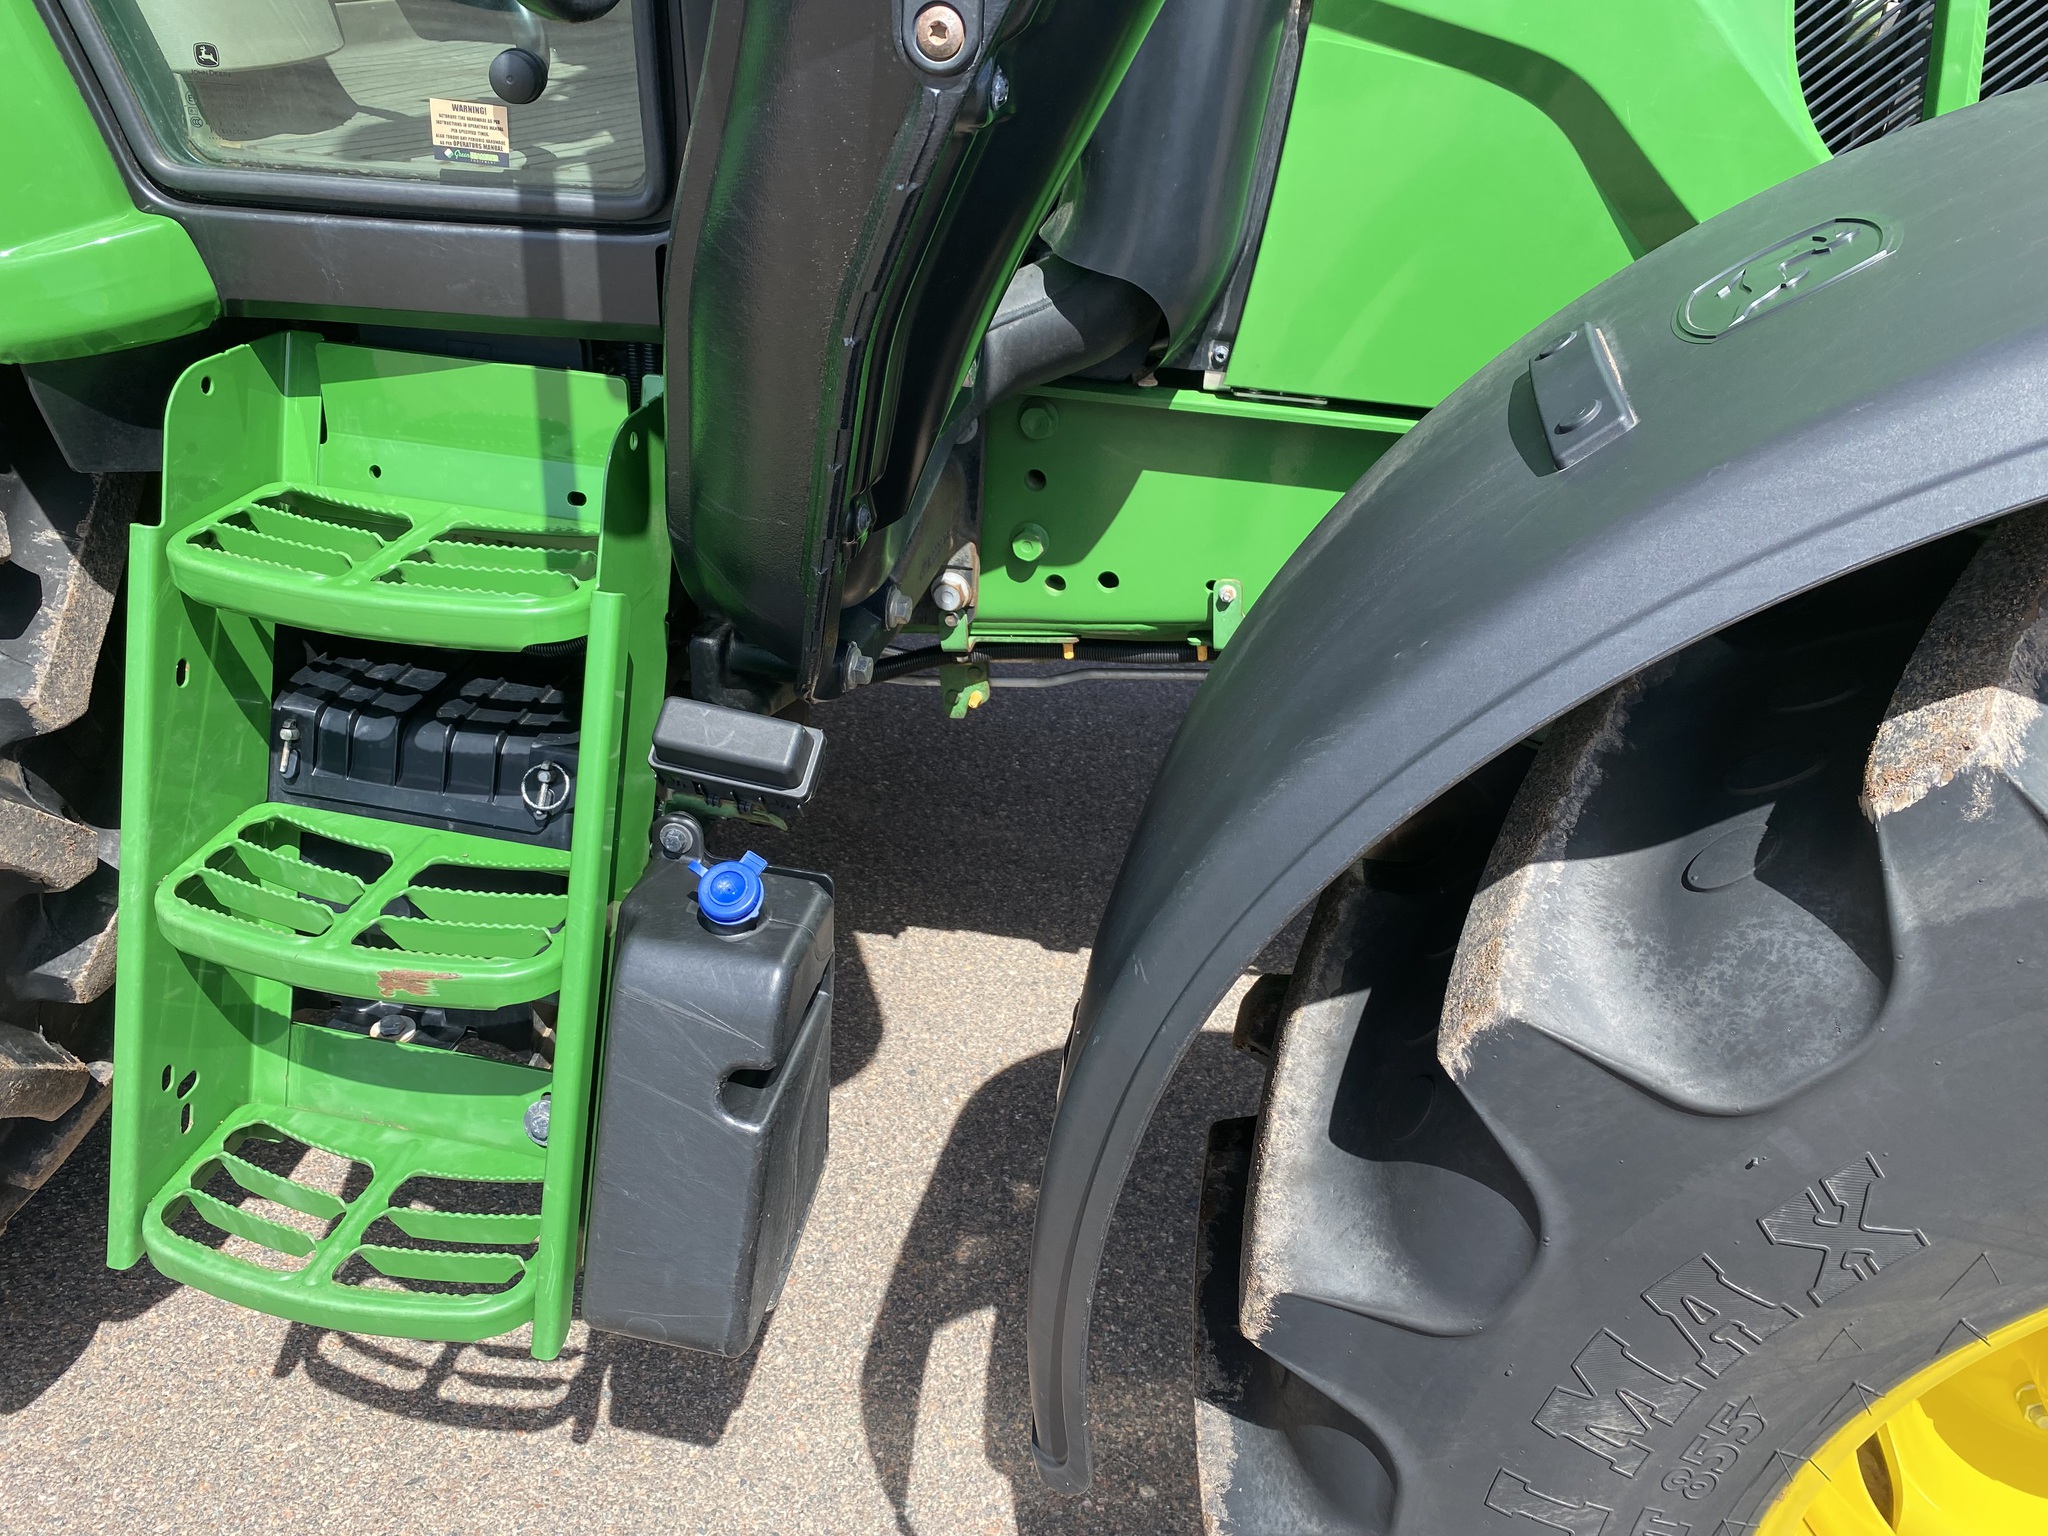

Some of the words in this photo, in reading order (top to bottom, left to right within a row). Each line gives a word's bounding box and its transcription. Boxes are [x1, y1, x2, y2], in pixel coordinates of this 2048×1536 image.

[452, 104, 487, 115] WARNING!
[453, 141, 482, 149] OPERATORS
[1660, 1400, 1767, 1501] 855
